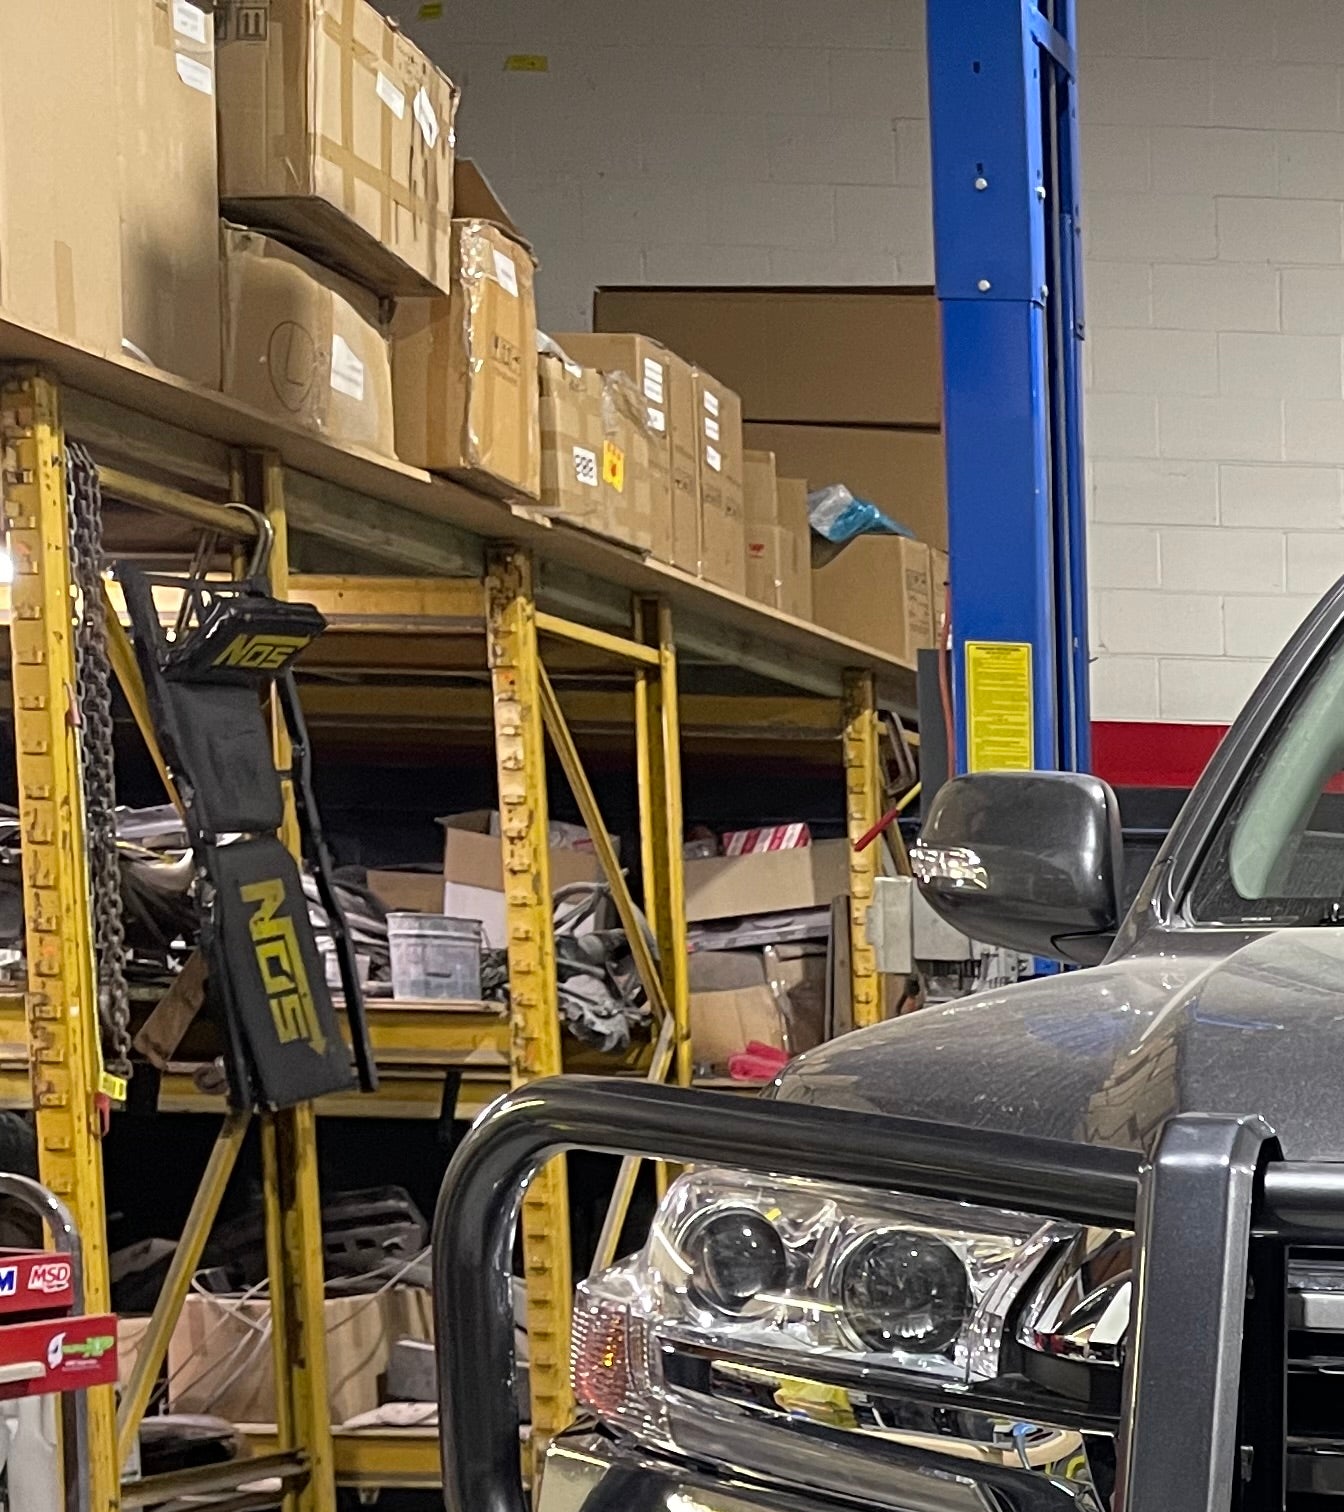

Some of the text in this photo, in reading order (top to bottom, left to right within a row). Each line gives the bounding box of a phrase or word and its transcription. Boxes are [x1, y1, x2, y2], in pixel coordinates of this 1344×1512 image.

[211, 633, 311, 669] NOS
[240, 878, 327, 1057] NOS
[31, 1266, 68, 1284] MSD
